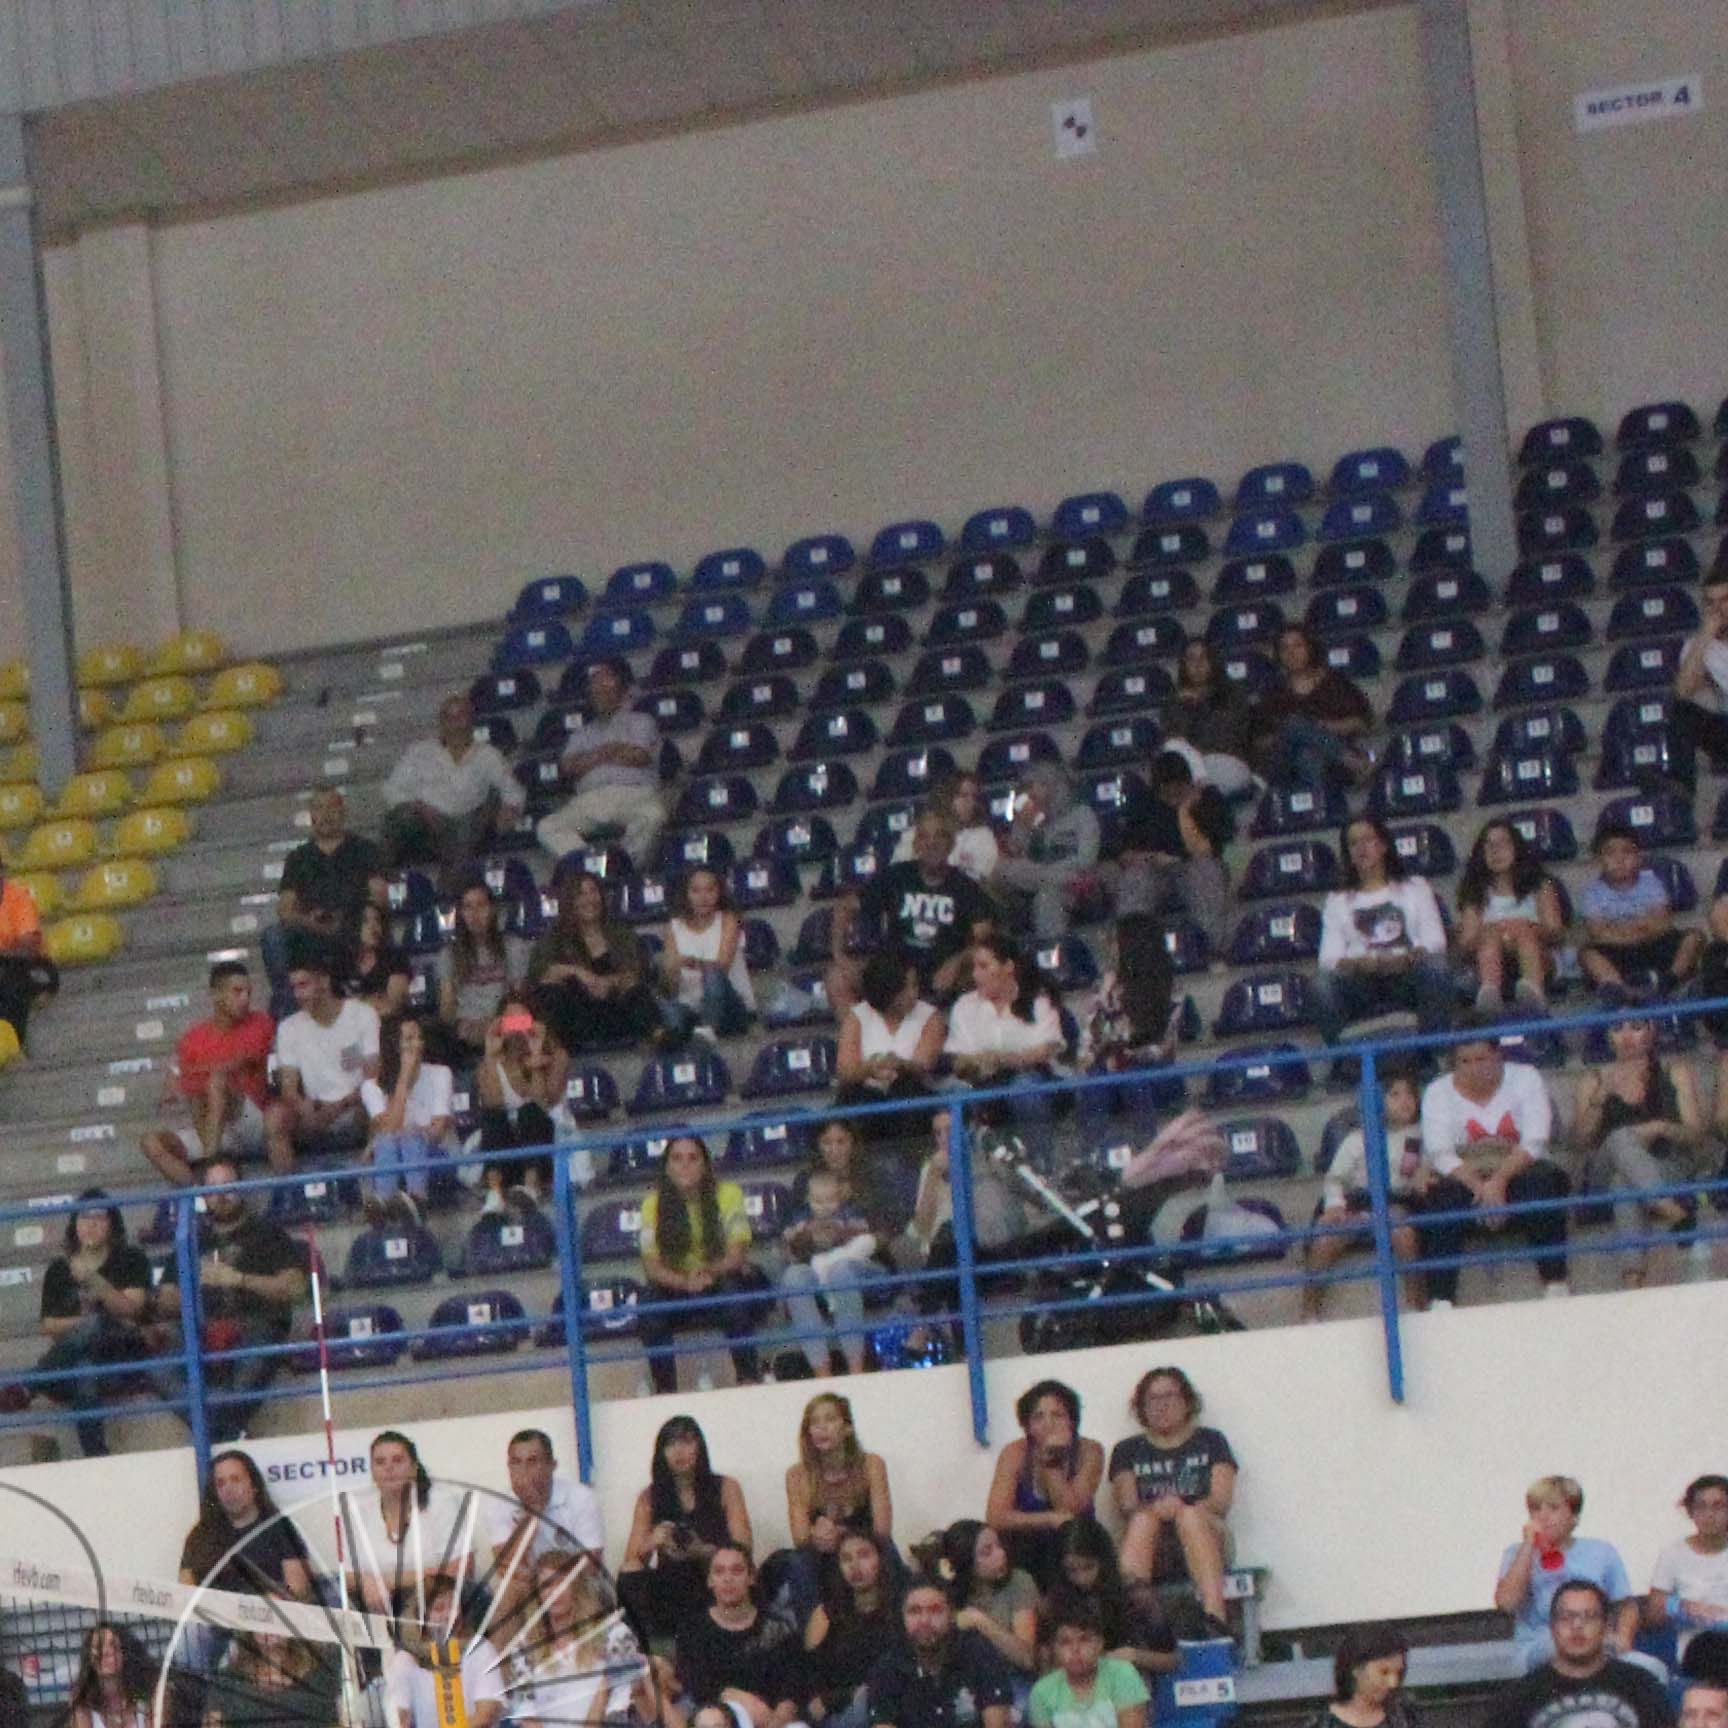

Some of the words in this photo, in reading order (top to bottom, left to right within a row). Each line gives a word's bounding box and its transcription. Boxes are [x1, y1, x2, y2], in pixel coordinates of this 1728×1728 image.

[1673, 85, 1691, 107] 4
[901, 892, 955, 924] NYC
[267, 1456, 367, 1484] SECTOR
